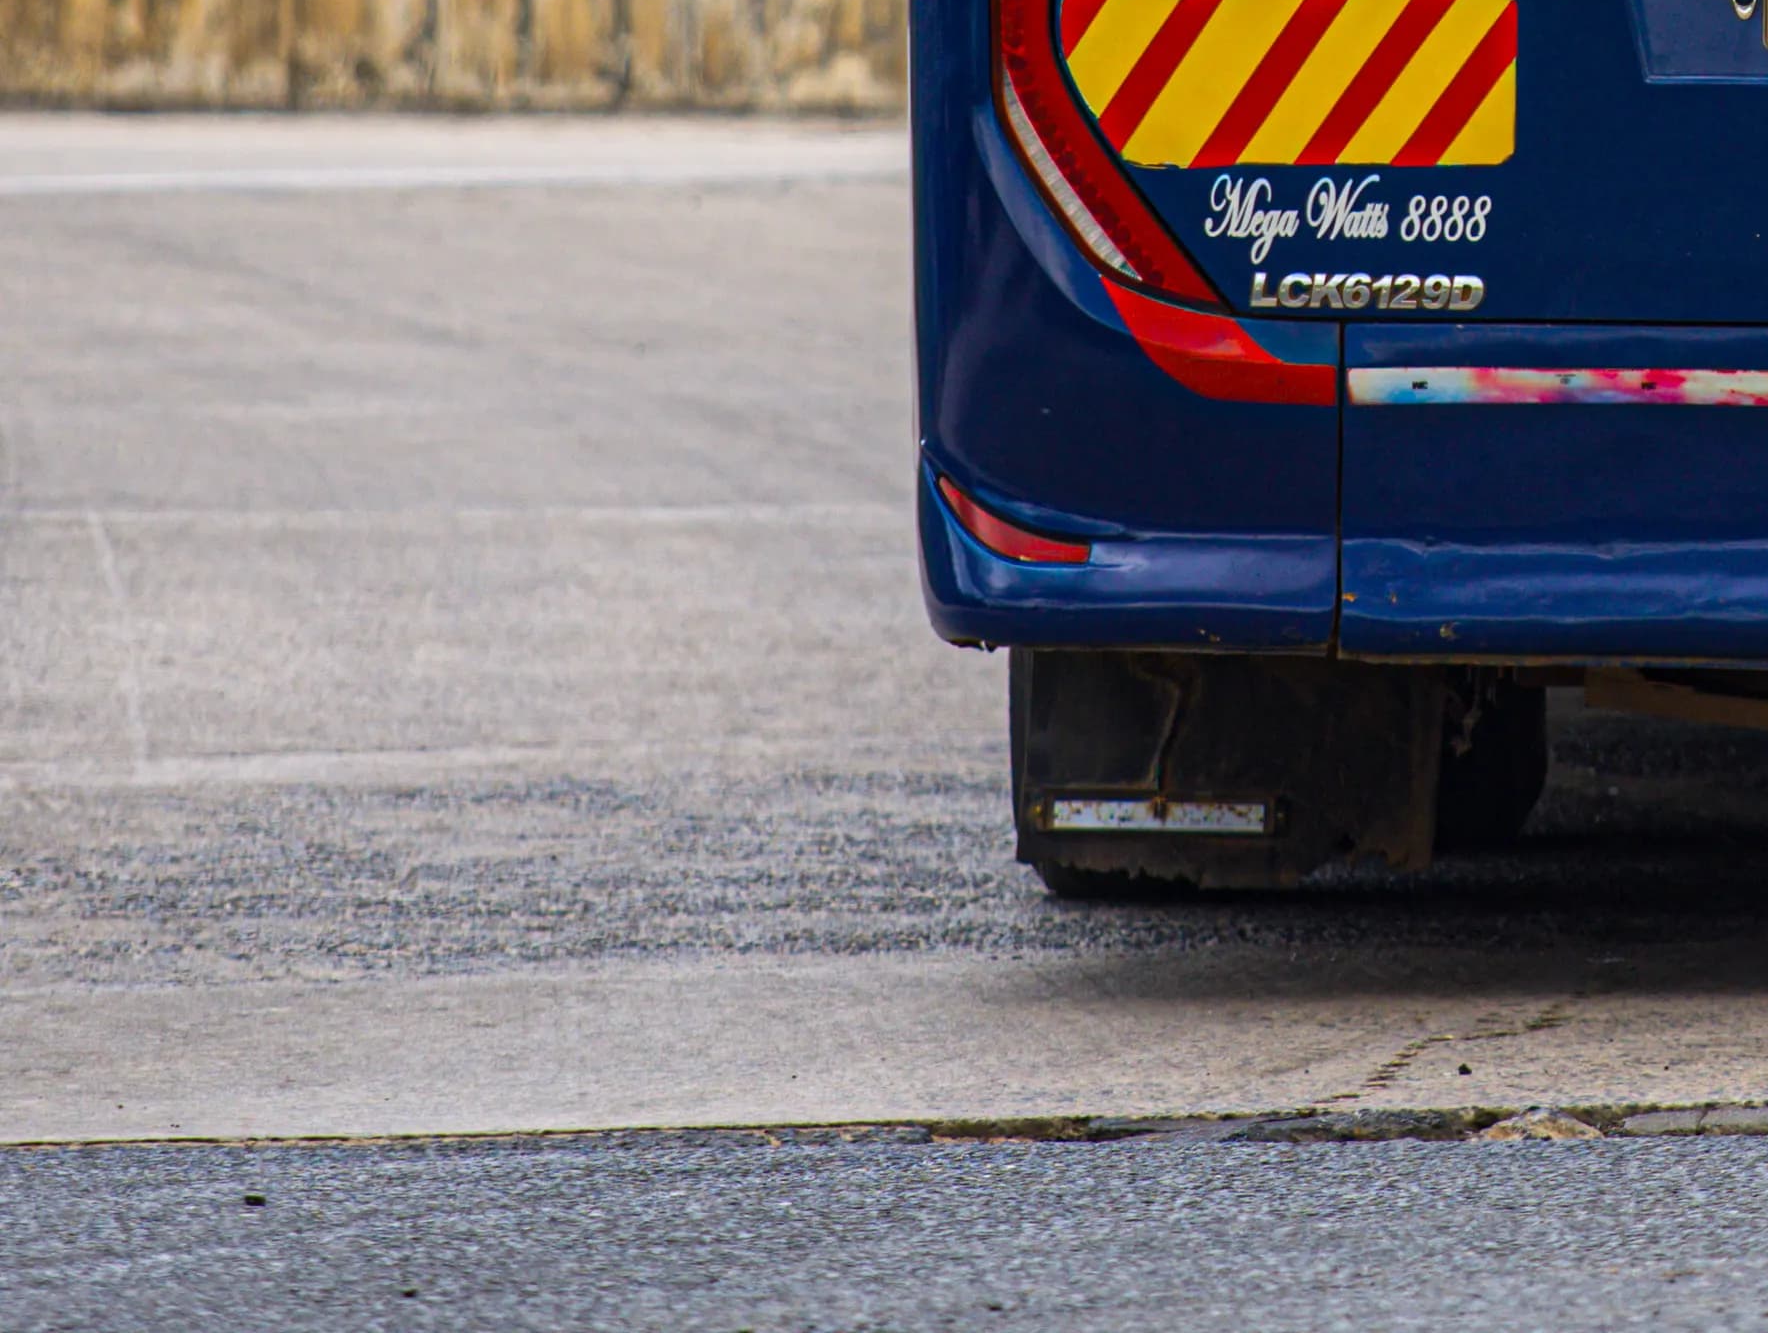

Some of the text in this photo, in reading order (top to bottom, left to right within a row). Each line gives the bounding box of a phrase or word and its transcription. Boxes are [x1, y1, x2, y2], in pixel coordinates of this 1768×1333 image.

[1204, 174, 1492, 265] Mega Watts 8888
[1250, 272, 1485, 311] LCK6129D
